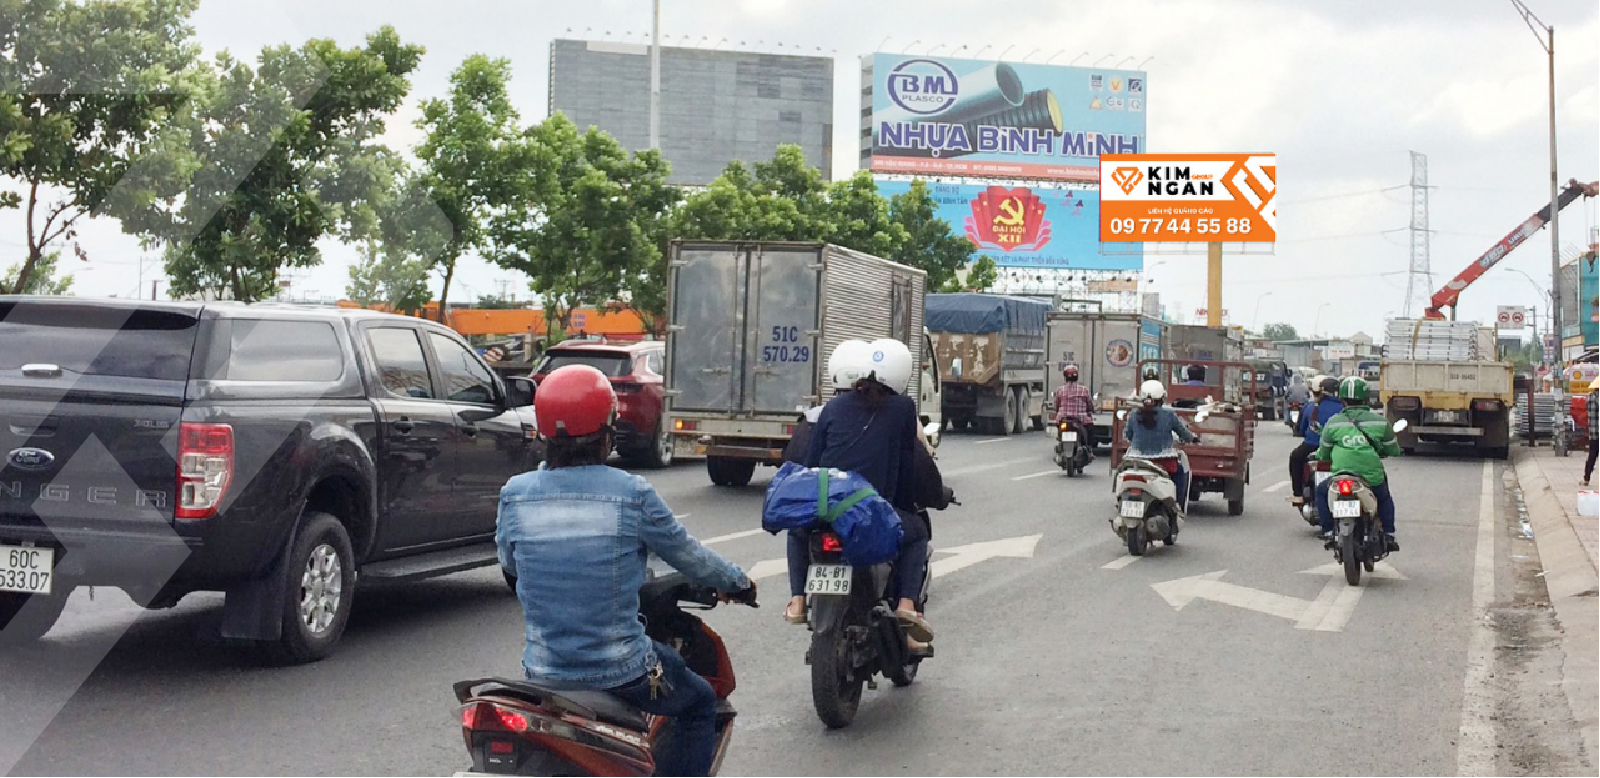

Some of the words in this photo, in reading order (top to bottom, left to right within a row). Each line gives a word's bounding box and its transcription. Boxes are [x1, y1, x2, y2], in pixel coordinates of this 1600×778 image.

[902, 75, 946, 94] BM
[902, 95, 944, 103] PLASCO
[880, 121, 972, 157] NHỰA
[1147, 166, 1190, 180] KIM
[1147, 182, 1213, 195] NGAN
[1110, 218, 1135, 234] 09
[997, 234, 1022, 242] XII
[772, 326, 798, 342] 51C
[763, 345, 810, 362] 570.29
[1342, 435, 1368, 447] Gra
[10, 550, 40, 569] 60C
